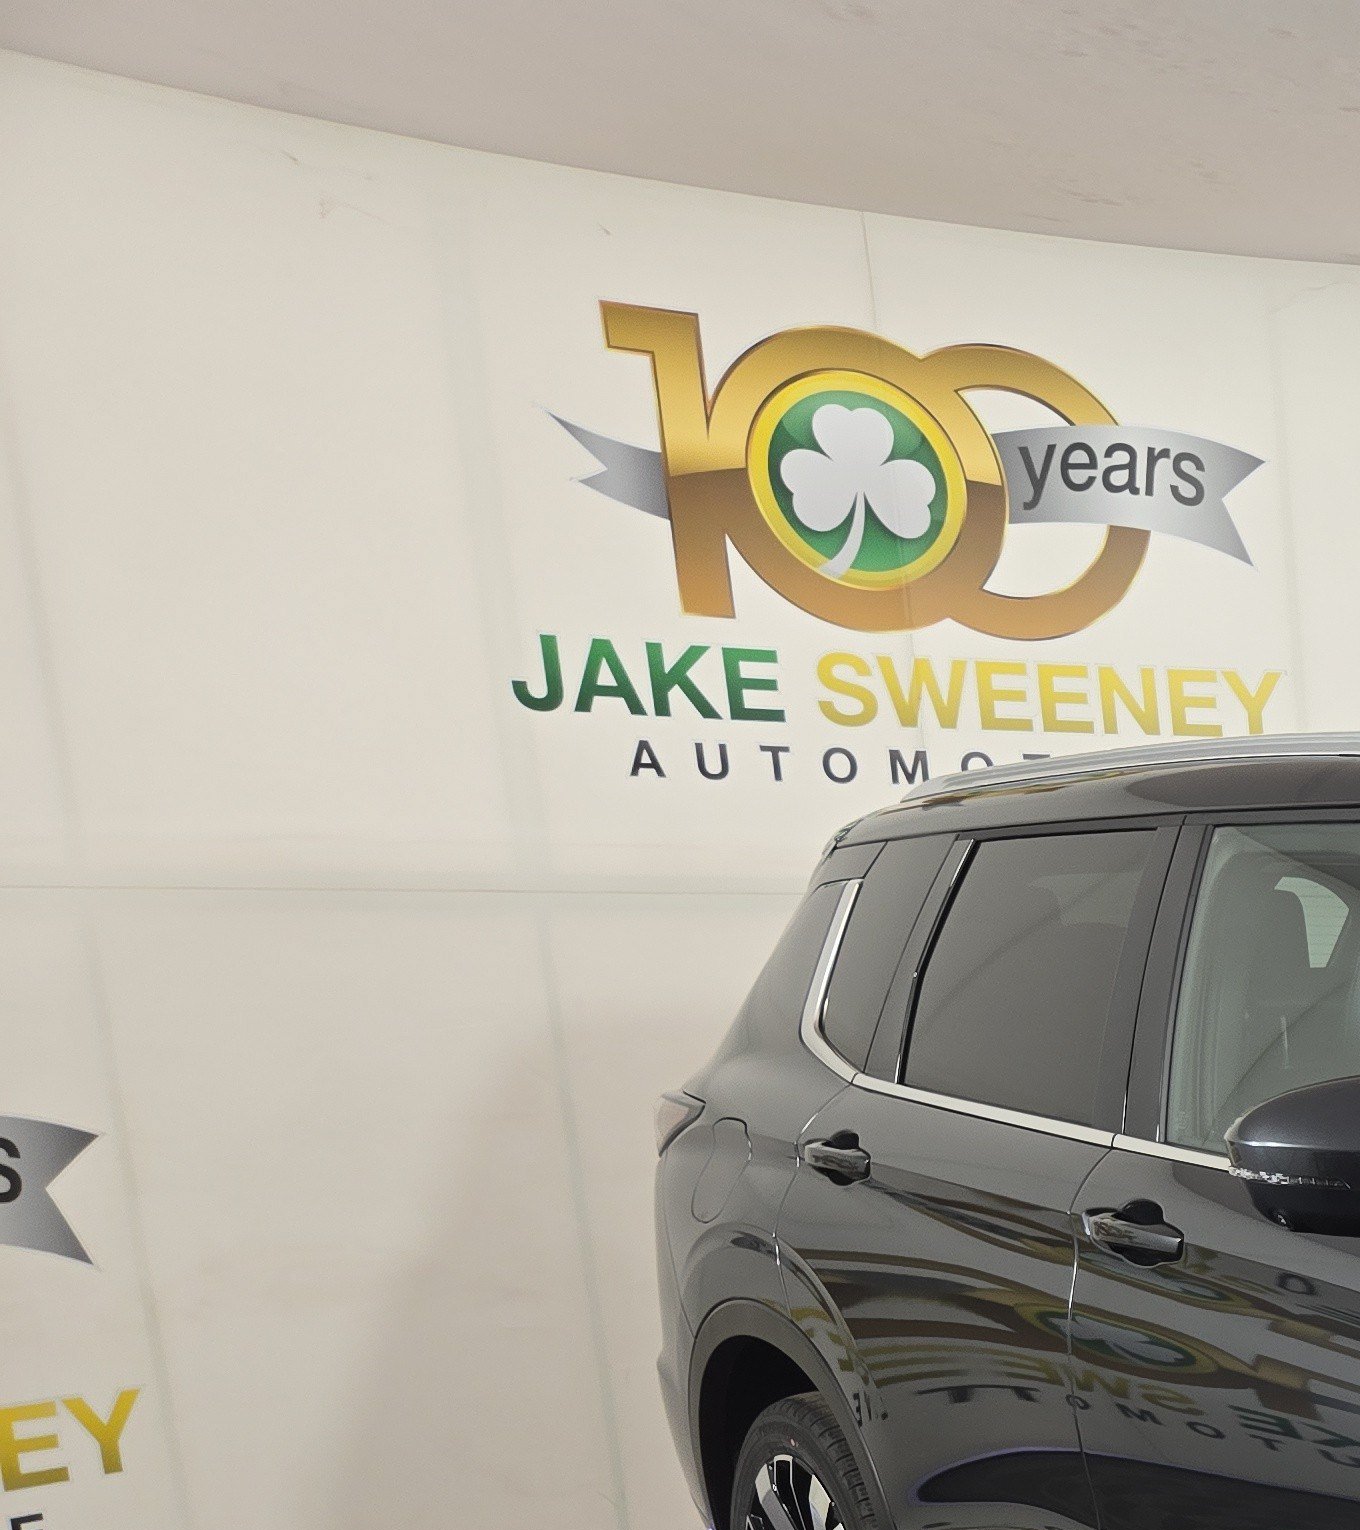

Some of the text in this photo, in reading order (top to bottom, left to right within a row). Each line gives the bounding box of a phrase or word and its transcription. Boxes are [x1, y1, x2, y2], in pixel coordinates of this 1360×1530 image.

[1018, 441, 1206, 510] years
[511, 633, 1287, 738] JAKE SWEENEY
[630, 739, 1051, 786] AUTOM
